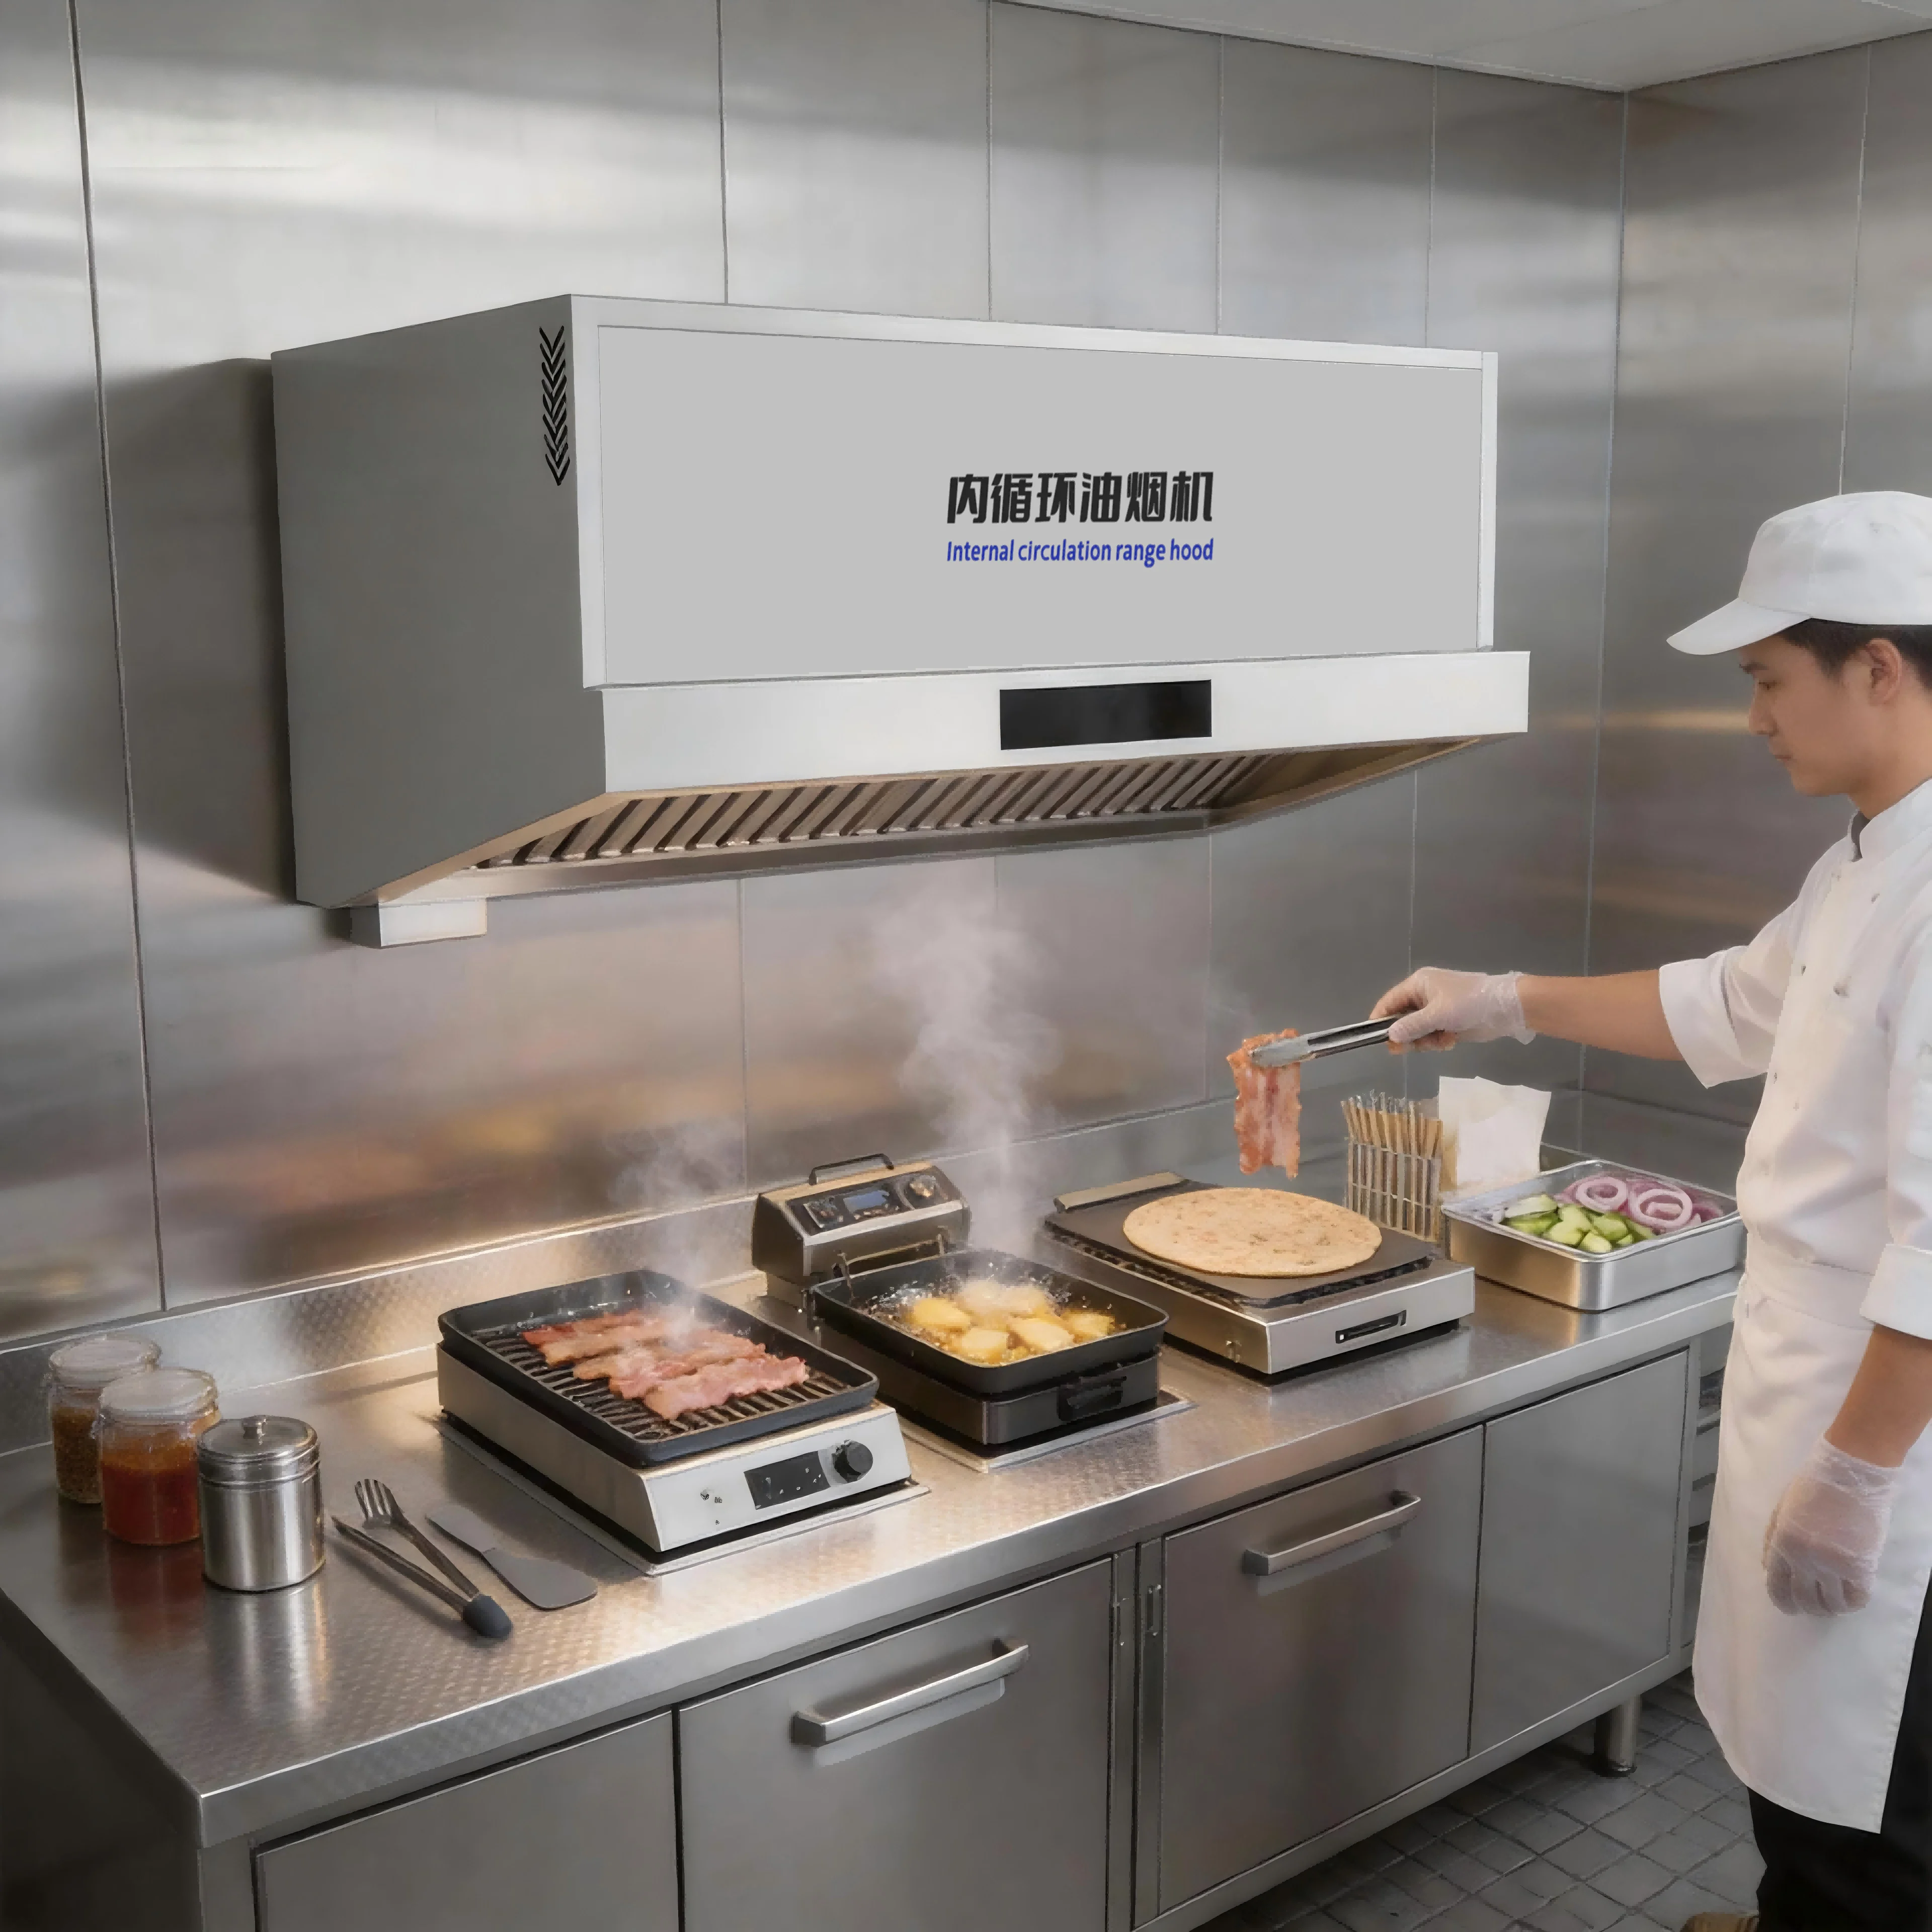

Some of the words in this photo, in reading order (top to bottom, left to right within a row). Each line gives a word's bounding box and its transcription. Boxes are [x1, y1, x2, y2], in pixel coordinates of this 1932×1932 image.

[946, 470, 1214, 524] 内循环油烟机
[946, 538, 1015, 562] Internal
[1017, 538, 1112, 561] circulation
[1115, 543, 1166, 569] range
[1169, 537, 1214, 561] hood
